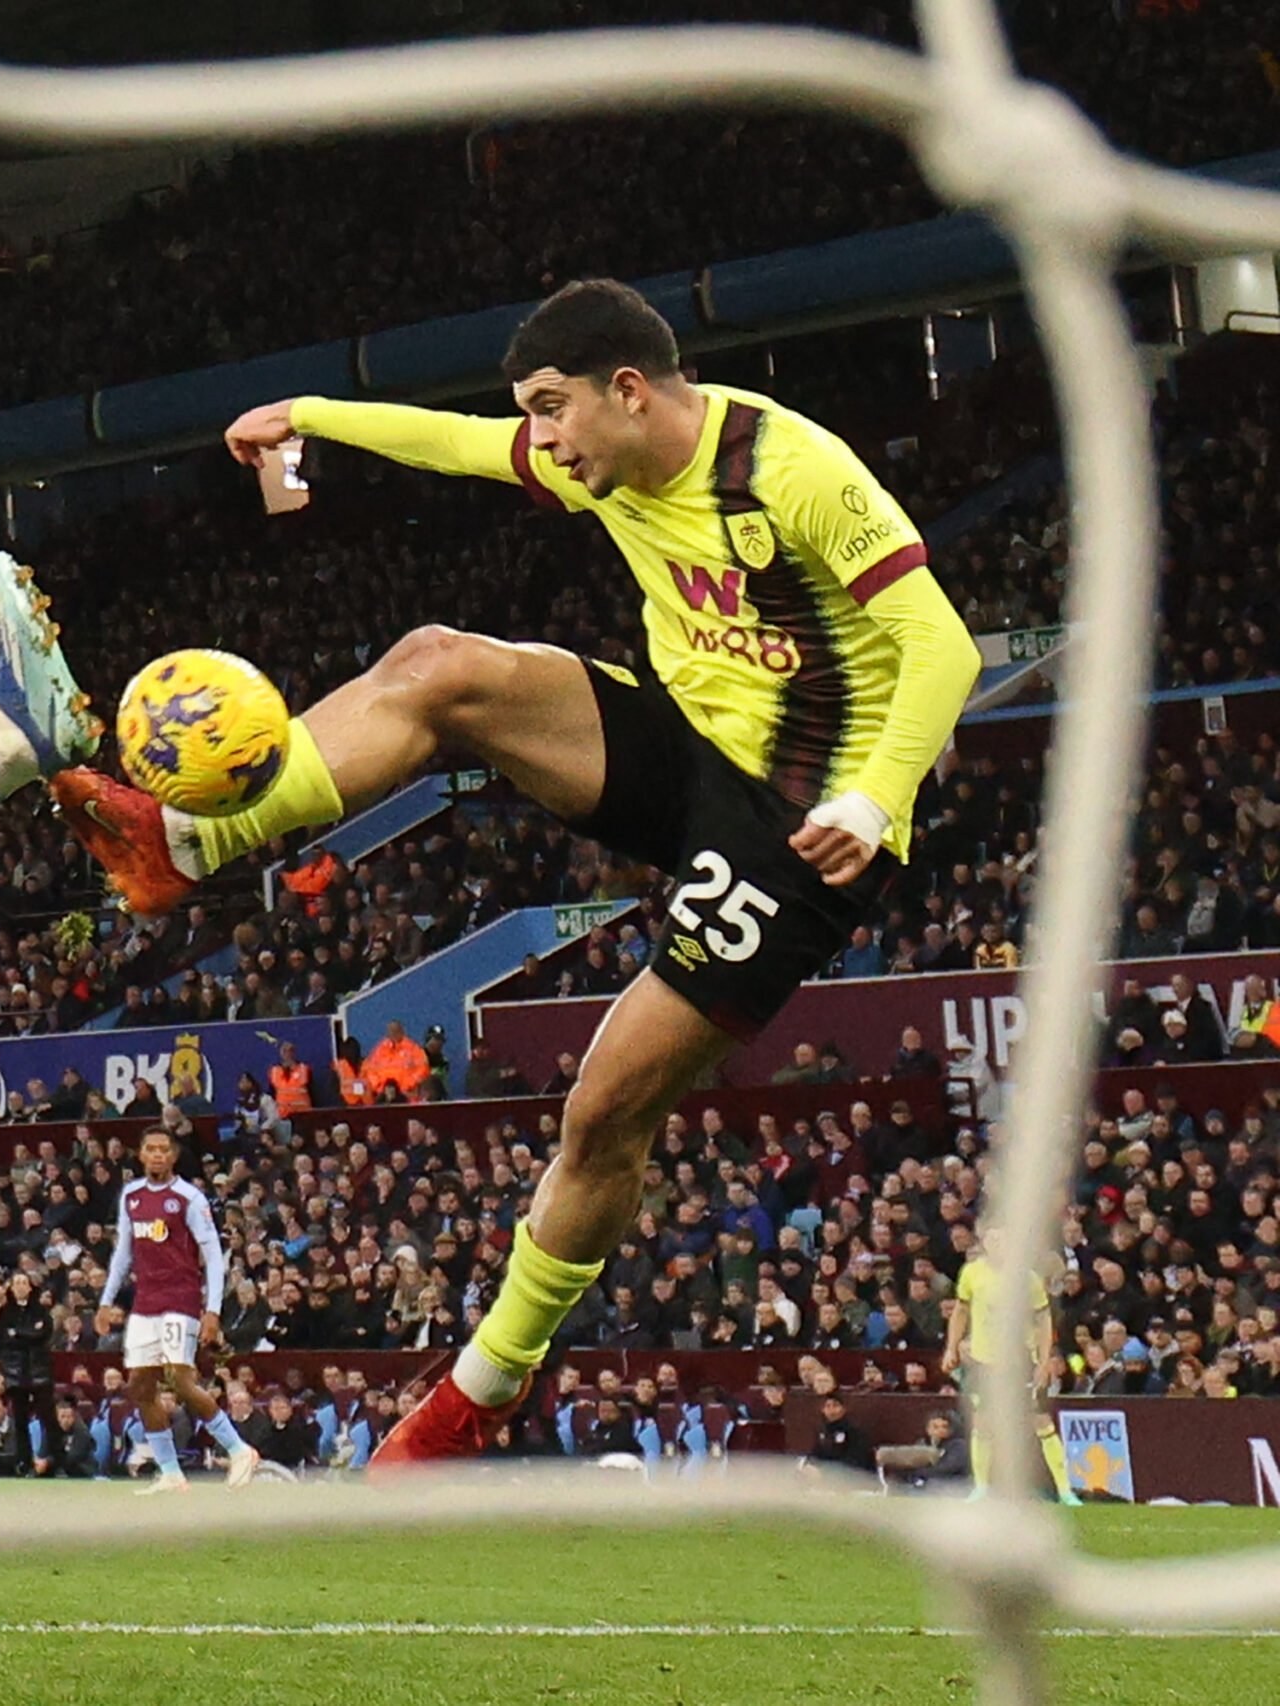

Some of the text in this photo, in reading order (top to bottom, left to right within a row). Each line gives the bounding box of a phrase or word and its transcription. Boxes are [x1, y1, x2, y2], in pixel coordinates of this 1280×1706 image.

[838, 516, 900, 562] uphol
[668, 850, 780, 962] 25
[164, 1322, 182, 1344] 31
[1068, 1419, 1122, 1442] AVFC
